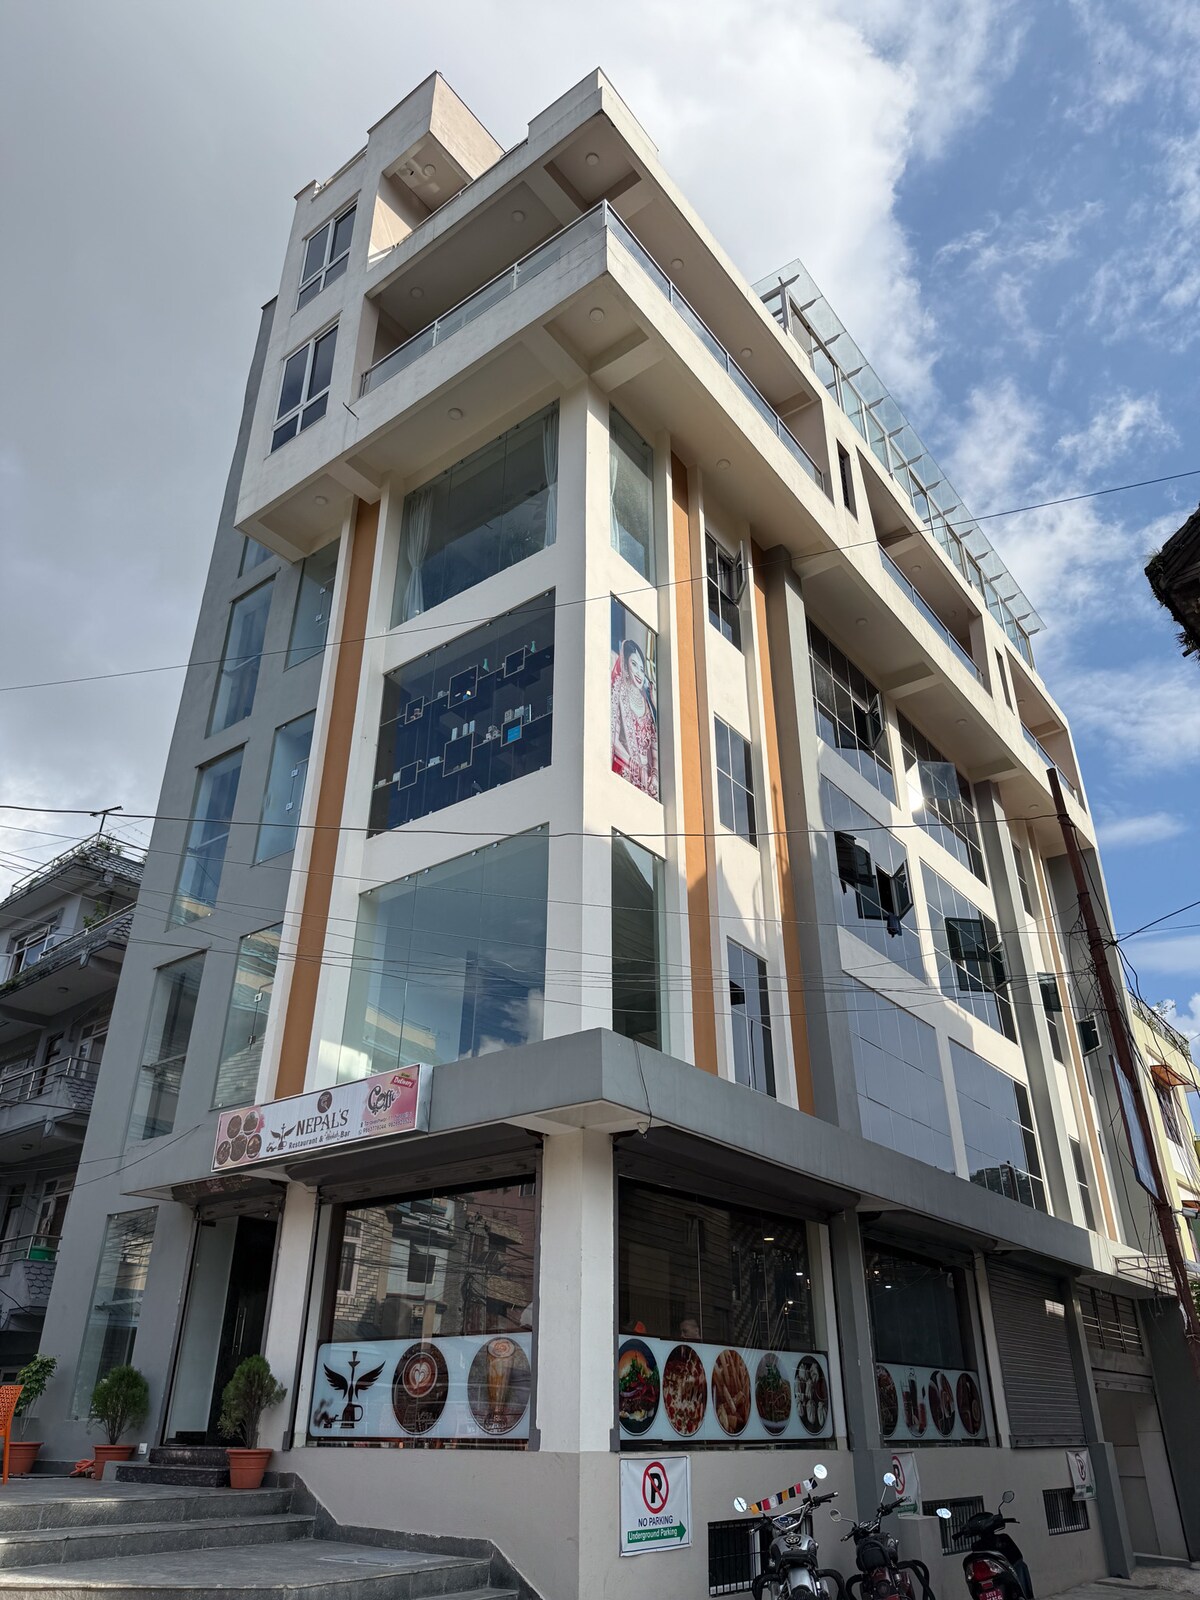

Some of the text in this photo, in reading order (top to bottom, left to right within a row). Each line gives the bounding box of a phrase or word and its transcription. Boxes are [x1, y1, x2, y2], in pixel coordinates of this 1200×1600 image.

[296, 1108, 349, 1136] NEPAL'S
[288, 1137, 318, 1149] Restaurant
[319, 1135, 324, 1143] &
[340, 1130, 351, 1138] Bar
[638, 1515, 673, 1527] NO PARKING
[628, 1527, 678, 1541] Underground Parking
